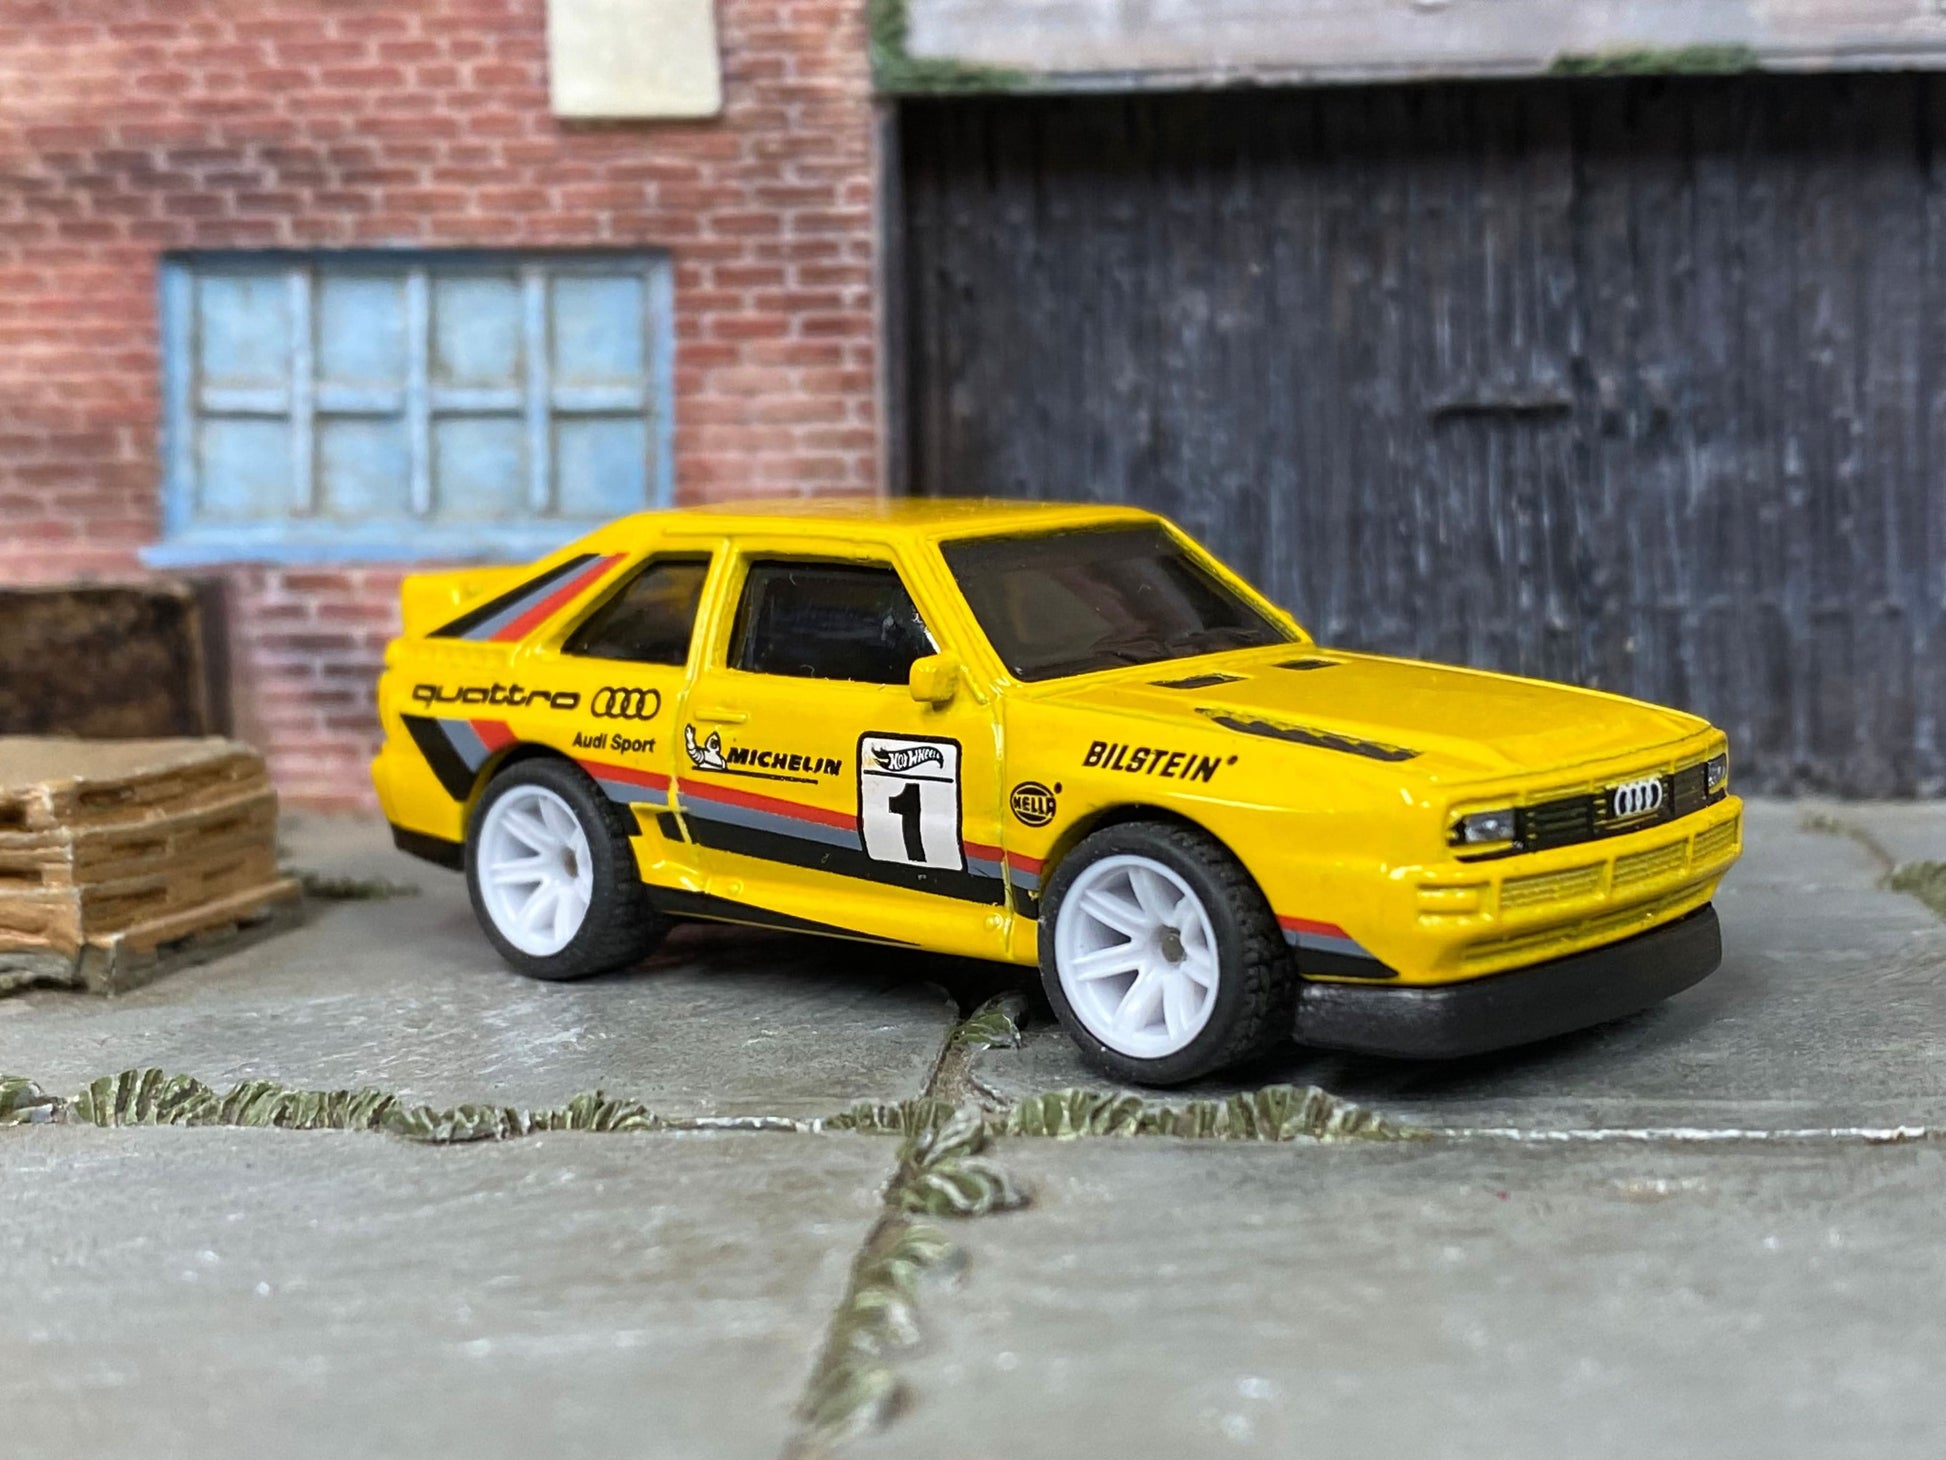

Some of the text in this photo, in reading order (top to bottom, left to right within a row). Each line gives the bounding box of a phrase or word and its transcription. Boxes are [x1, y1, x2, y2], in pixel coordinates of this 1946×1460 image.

[412, 684, 580, 709] quattro
[572, 731, 656, 755] Audi Sport
[726, 747, 842, 776] MICHELIN
[1082, 741, 1221, 783] BILSTEIN
[1013, 795, 1055, 817] HELLA
[889, 783, 926, 862] 1
